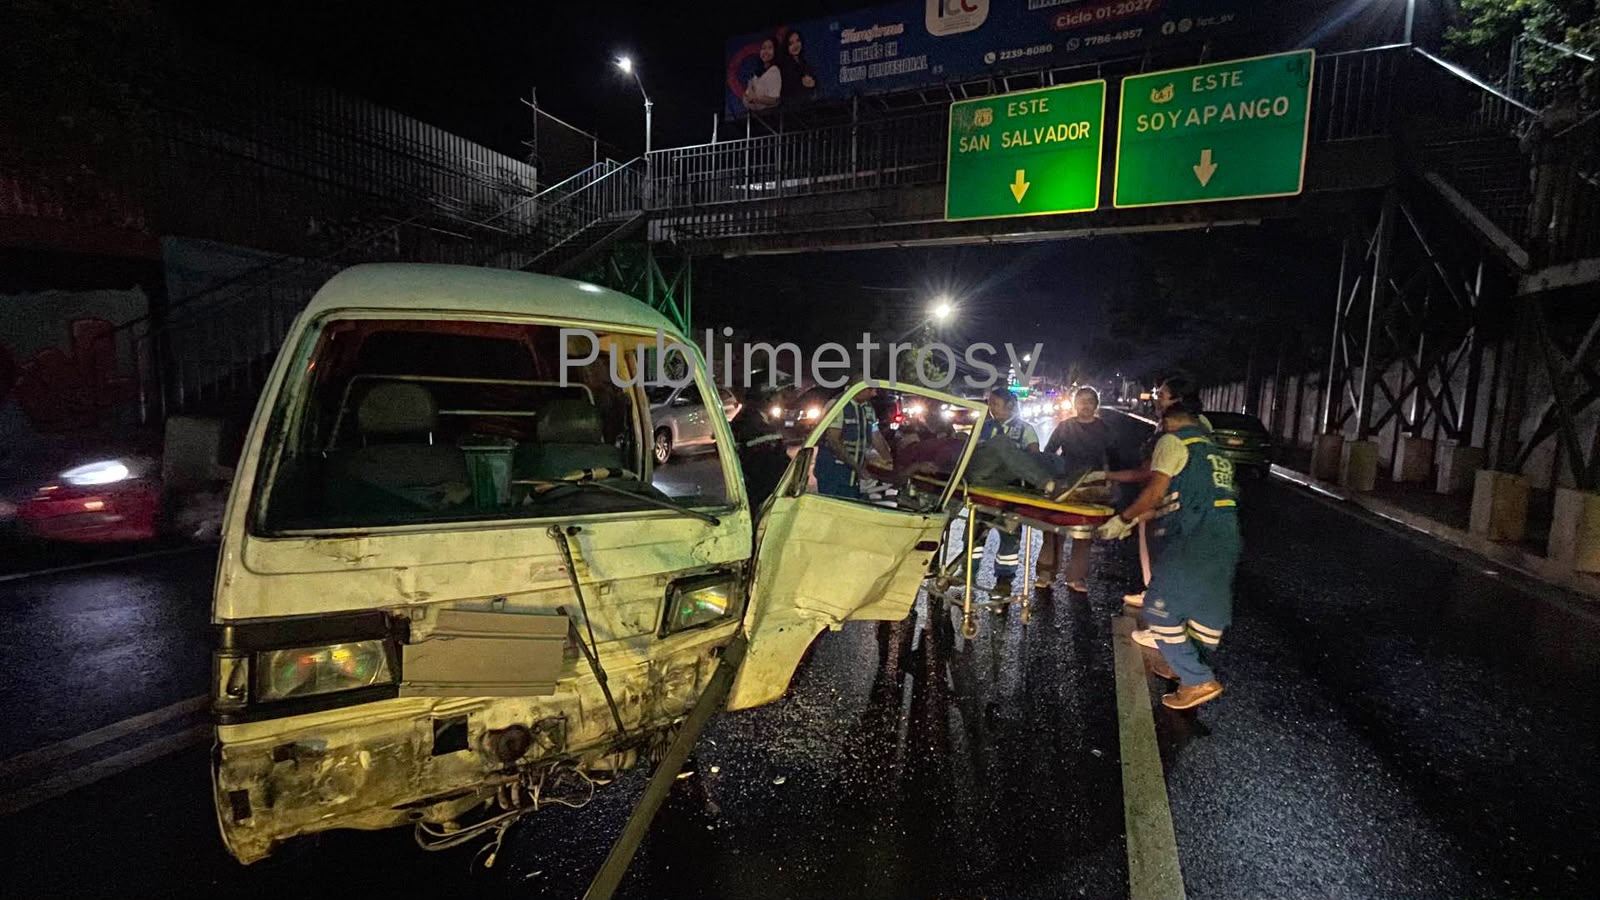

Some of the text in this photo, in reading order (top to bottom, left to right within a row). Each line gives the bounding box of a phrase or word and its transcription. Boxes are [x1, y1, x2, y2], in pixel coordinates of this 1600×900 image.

[1056, 0, 1153, 27] Ciclo 01-2027
[840, 24, 904, 44] Transforma
[1084, 28, 1143, 46] 7786-4957
[840, 50, 851, 65] EL
[852, 42, 883, 63] INGLÉS
[1000, 44, 1053, 60] 2239-8080
[868, 55, 929, 78] PROFESIONAL
[1192, 70, 1243, 92] ESTE
[1007, 98, 1049, 117] ESTE
[1136, 96, 1289, 132] SOYAPANGO
[959, 121, 1090, 153] SAN SALVADOR
